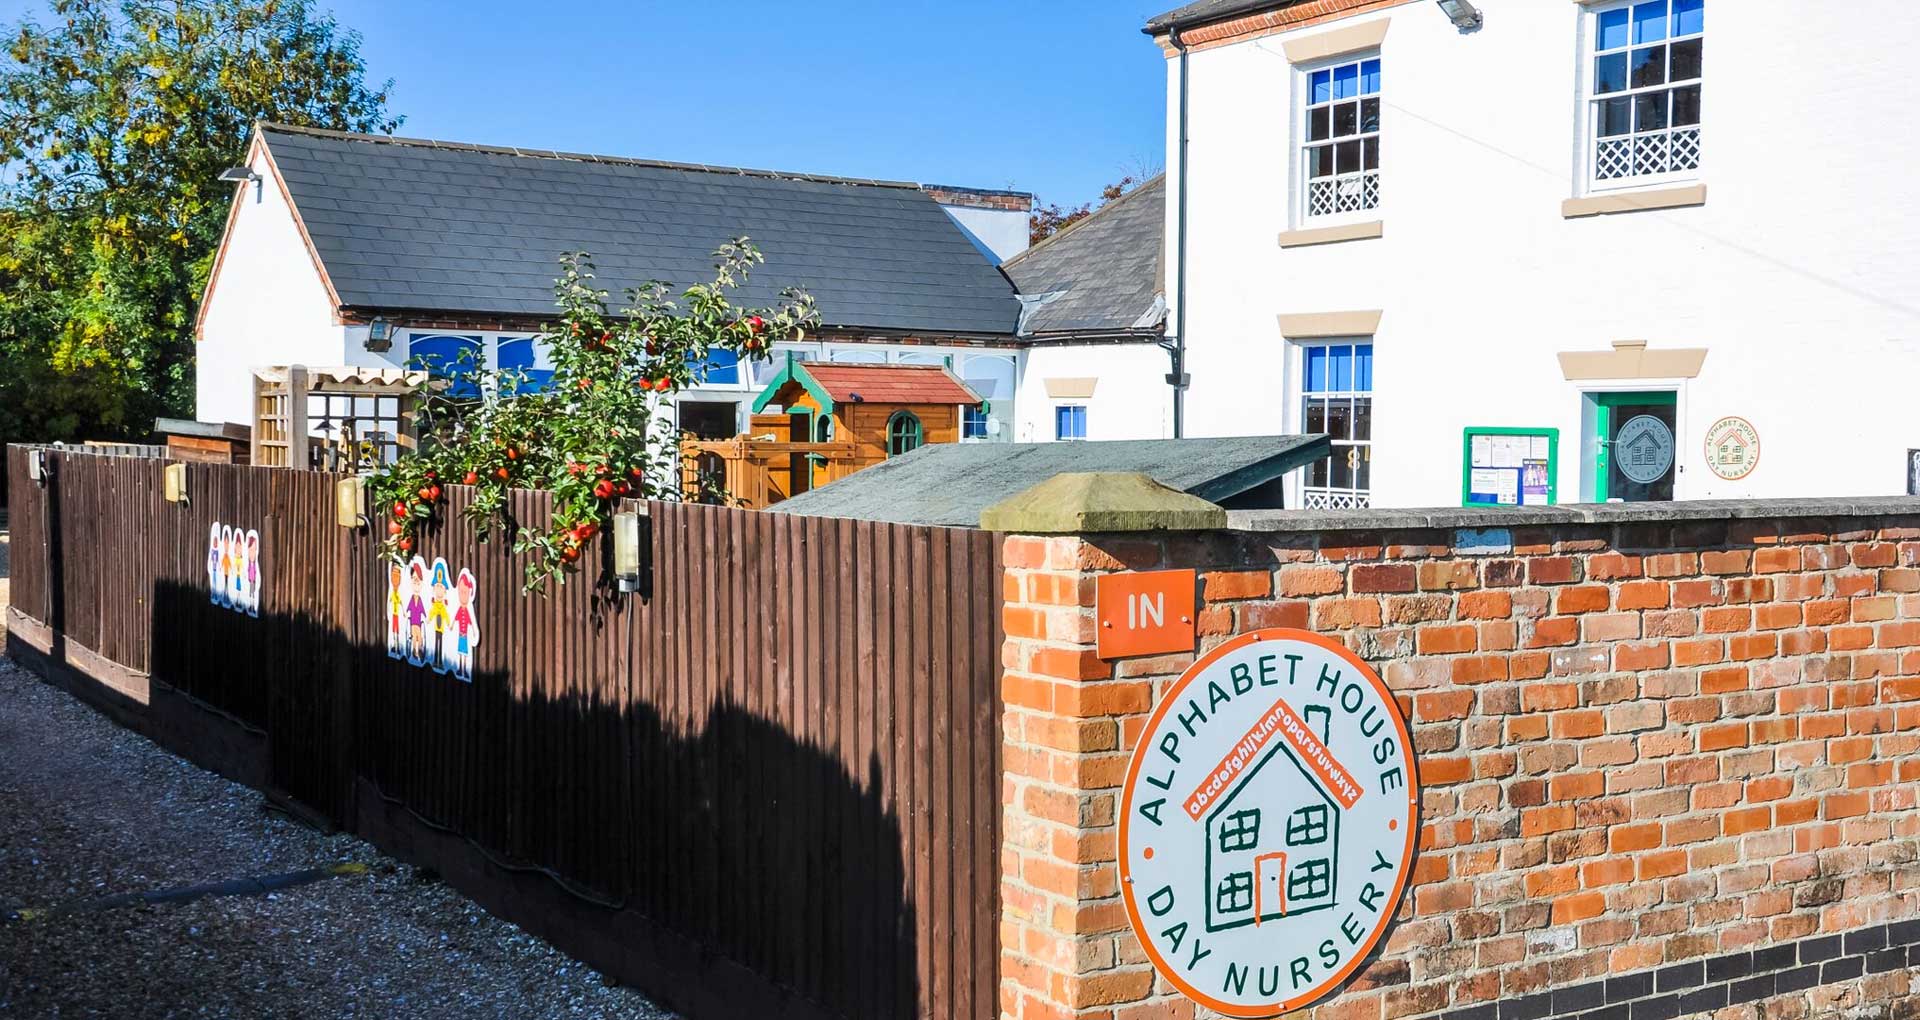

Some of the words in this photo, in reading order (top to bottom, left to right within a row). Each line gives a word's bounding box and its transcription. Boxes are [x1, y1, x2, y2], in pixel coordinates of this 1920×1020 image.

[1707, 420, 1736, 446] ALPHABET
[1738, 422, 1756, 446] HOUSE
[1708, 455, 1719, 470] DAY
[1721, 455, 1755, 478] NURSERY
[1128, 591, 1164, 630] IN
[1139, 654, 1303, 826] ALPHABET
[1315, 663, 1403, 795] HOUSE
[1147, 885, 1212, 971] DAY
[1223, 850, 1394, 997] NURSERY
